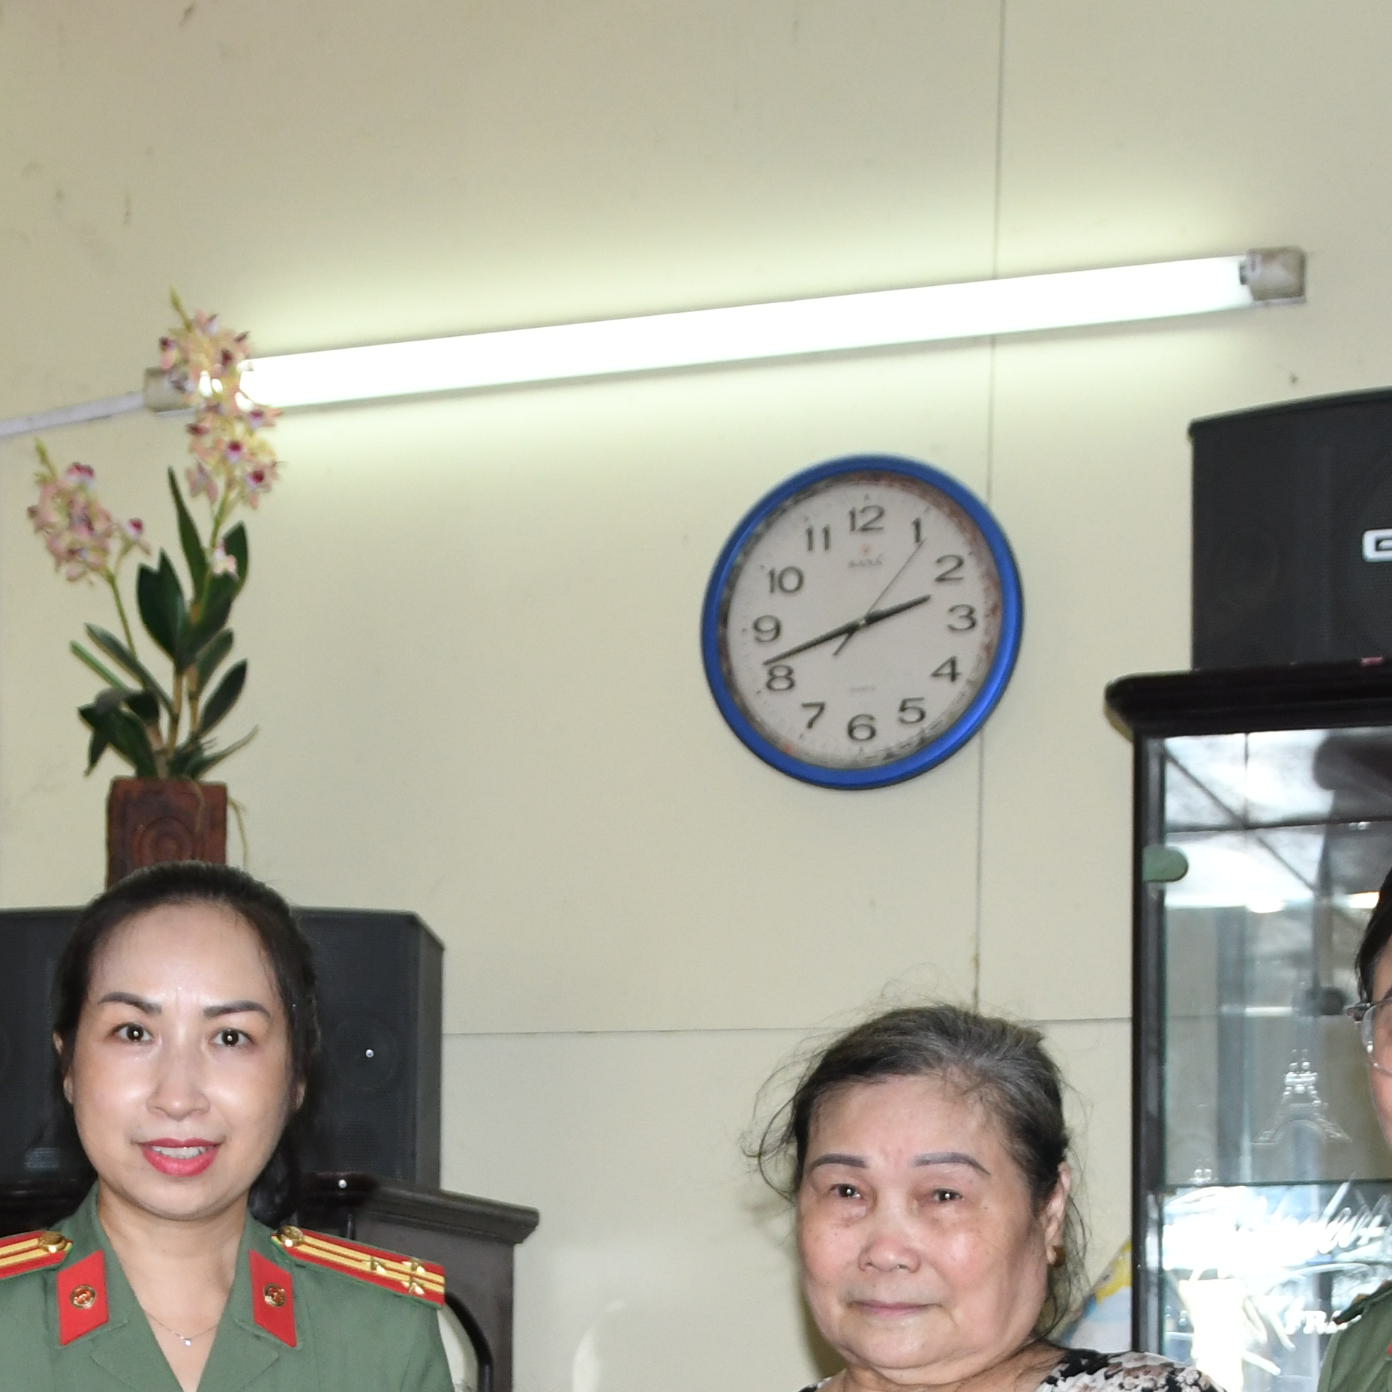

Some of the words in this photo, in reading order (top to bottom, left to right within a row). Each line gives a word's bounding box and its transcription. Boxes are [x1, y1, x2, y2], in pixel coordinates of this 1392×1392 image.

[849, 505, 885, 532] 12
[912, 518, 922, 543] 1
[806, 524, 831, 551] 11
[767, 566, 804, 593] 10
[934, 555, 964, 583] 2
[753, 615, 781, 642] 9
[947, 605, 977, 632] 3
[766, 664, 795, 691] 8
[930, 656, 962, 682] 4
[801, 702, 825, 729] 7
[898, 698, 926, 724] 5
[847, 715, 876, 741] 6
